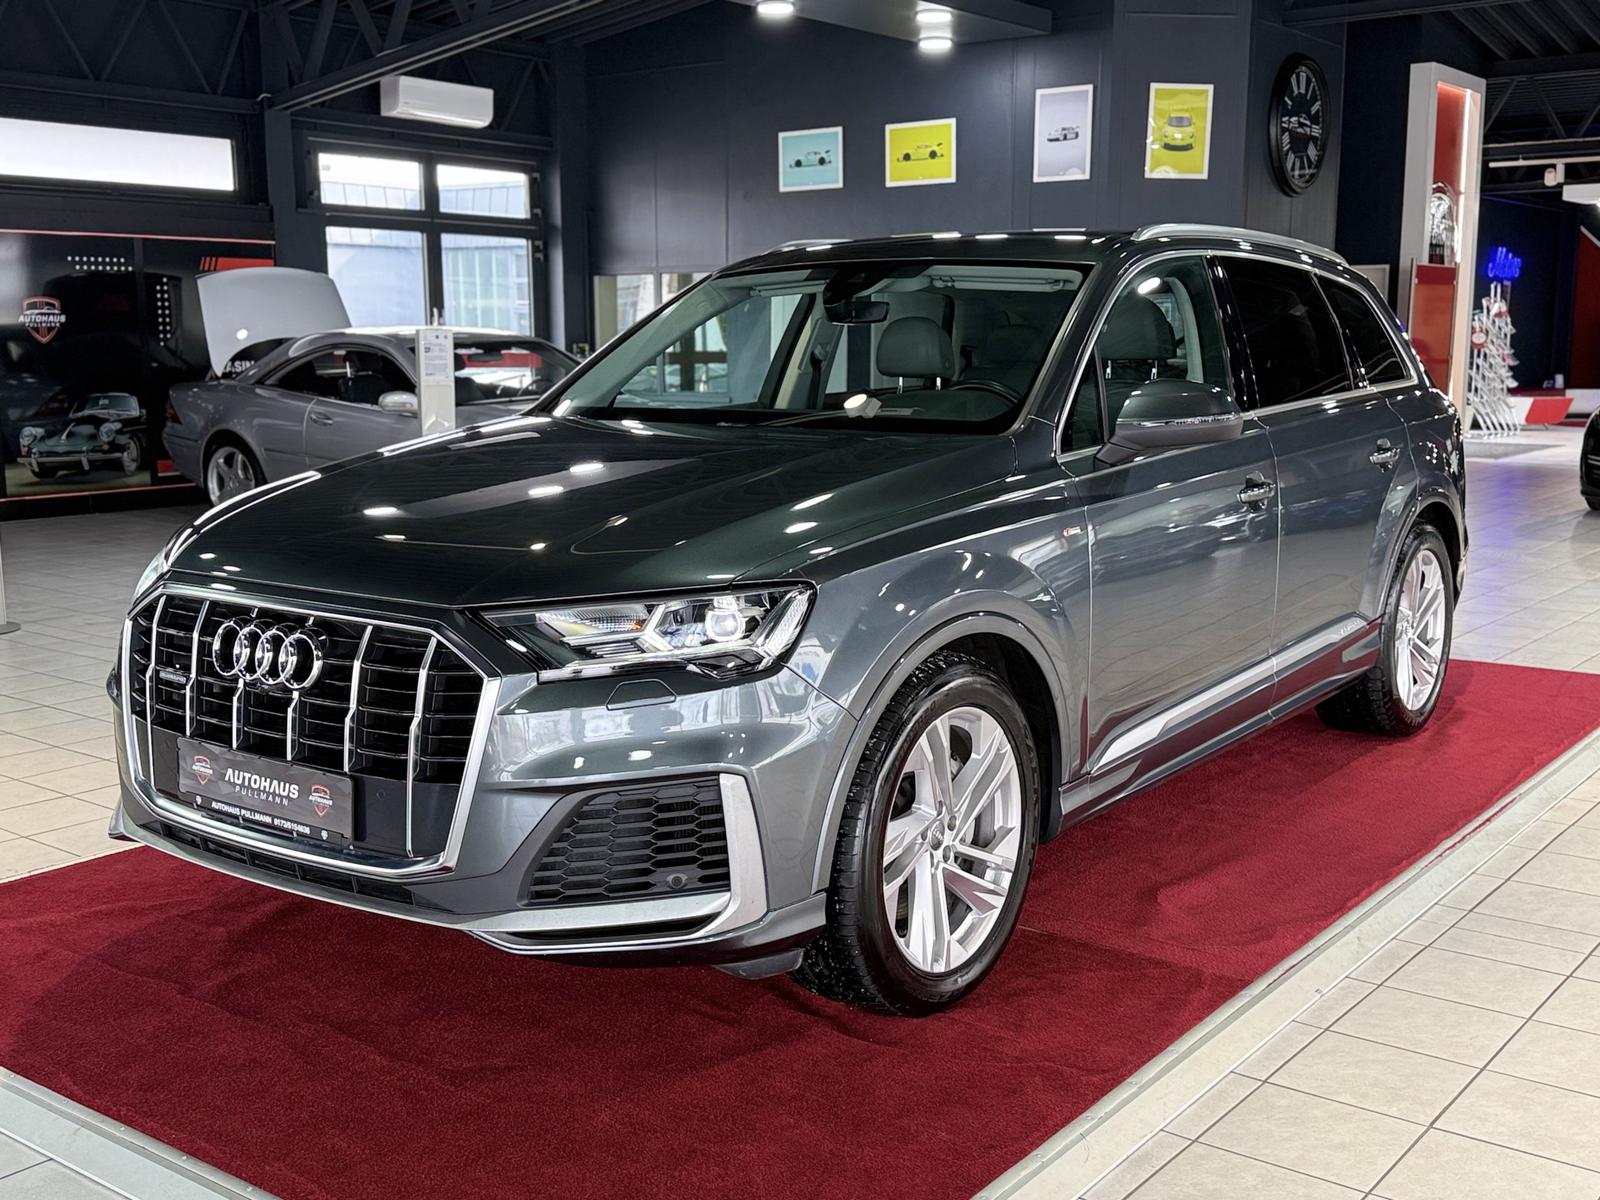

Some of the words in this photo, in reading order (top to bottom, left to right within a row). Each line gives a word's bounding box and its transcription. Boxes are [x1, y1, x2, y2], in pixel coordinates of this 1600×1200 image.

[18, 314, 67, 323] AUTOHAUS
[225, 768, 299, 798] AUTOHAUS
[234, 786, 289, 805] PULLMANN
[211, 801, 241, 815] AUTOHAUS
[241, 808, 272, 823] PULLMANN
